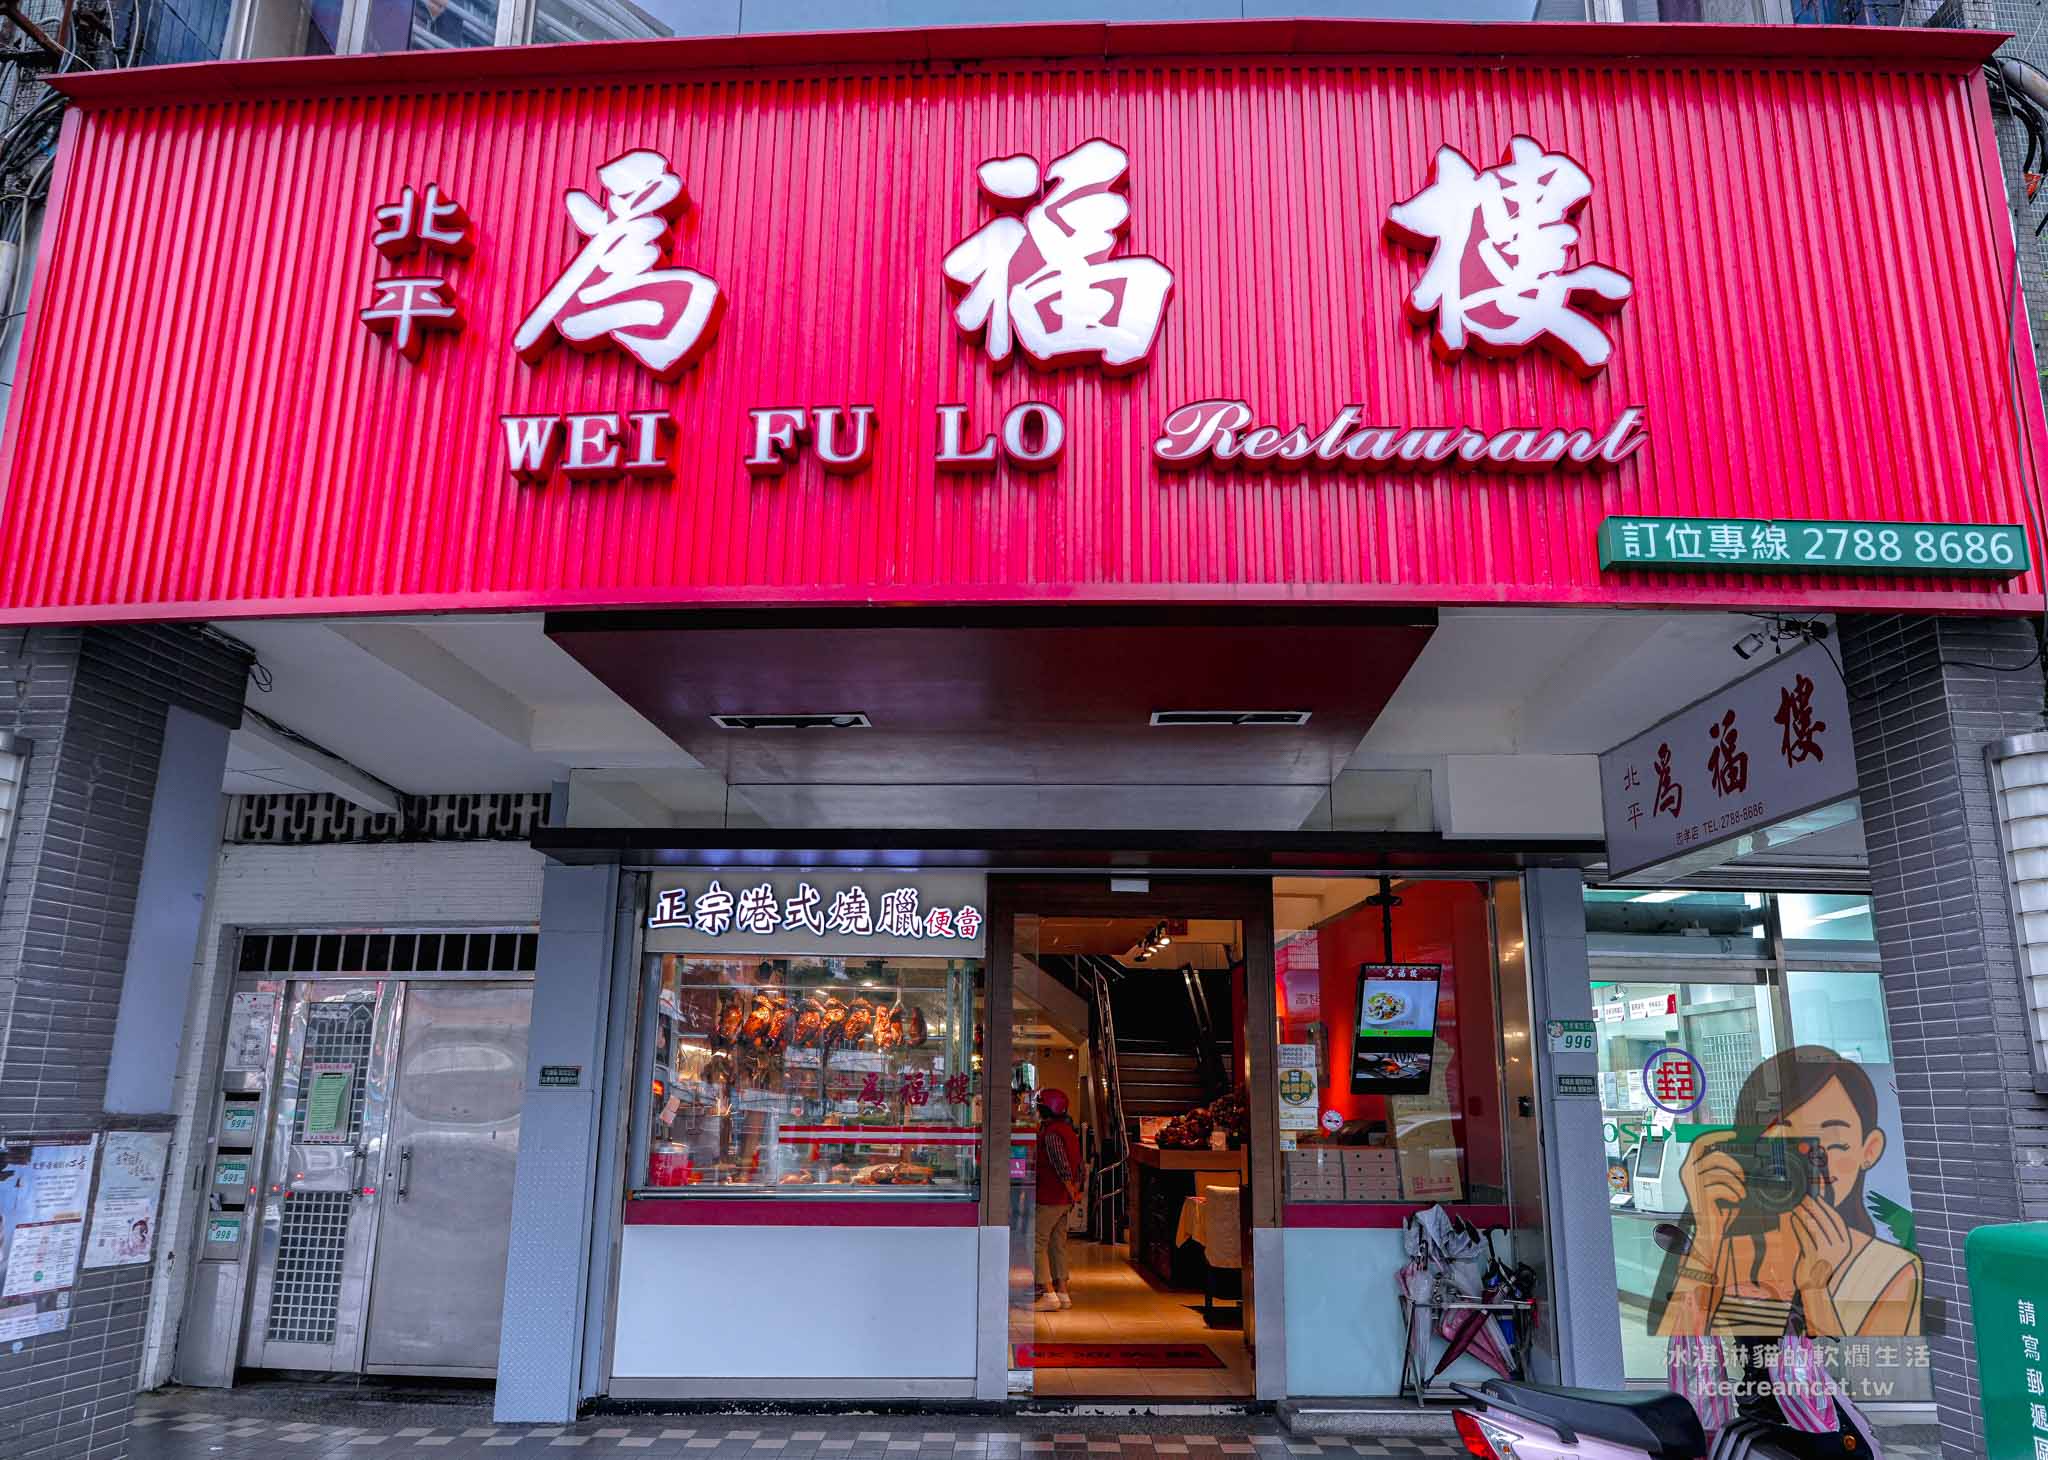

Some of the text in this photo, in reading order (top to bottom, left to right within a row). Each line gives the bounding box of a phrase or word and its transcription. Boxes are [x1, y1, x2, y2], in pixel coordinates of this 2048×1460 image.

[361, 183, 466, 352] 北平
[501, 400, 1649, 472] WEI FU LO Restaurant
[1621, 522, 2015, 565] 訂位專線 2788 8686
[1623, 764, 1644, 832] 北平
[1565, 1034, 1592, 1049] 996
[1656, 1060, 1696, 1101] 郵
